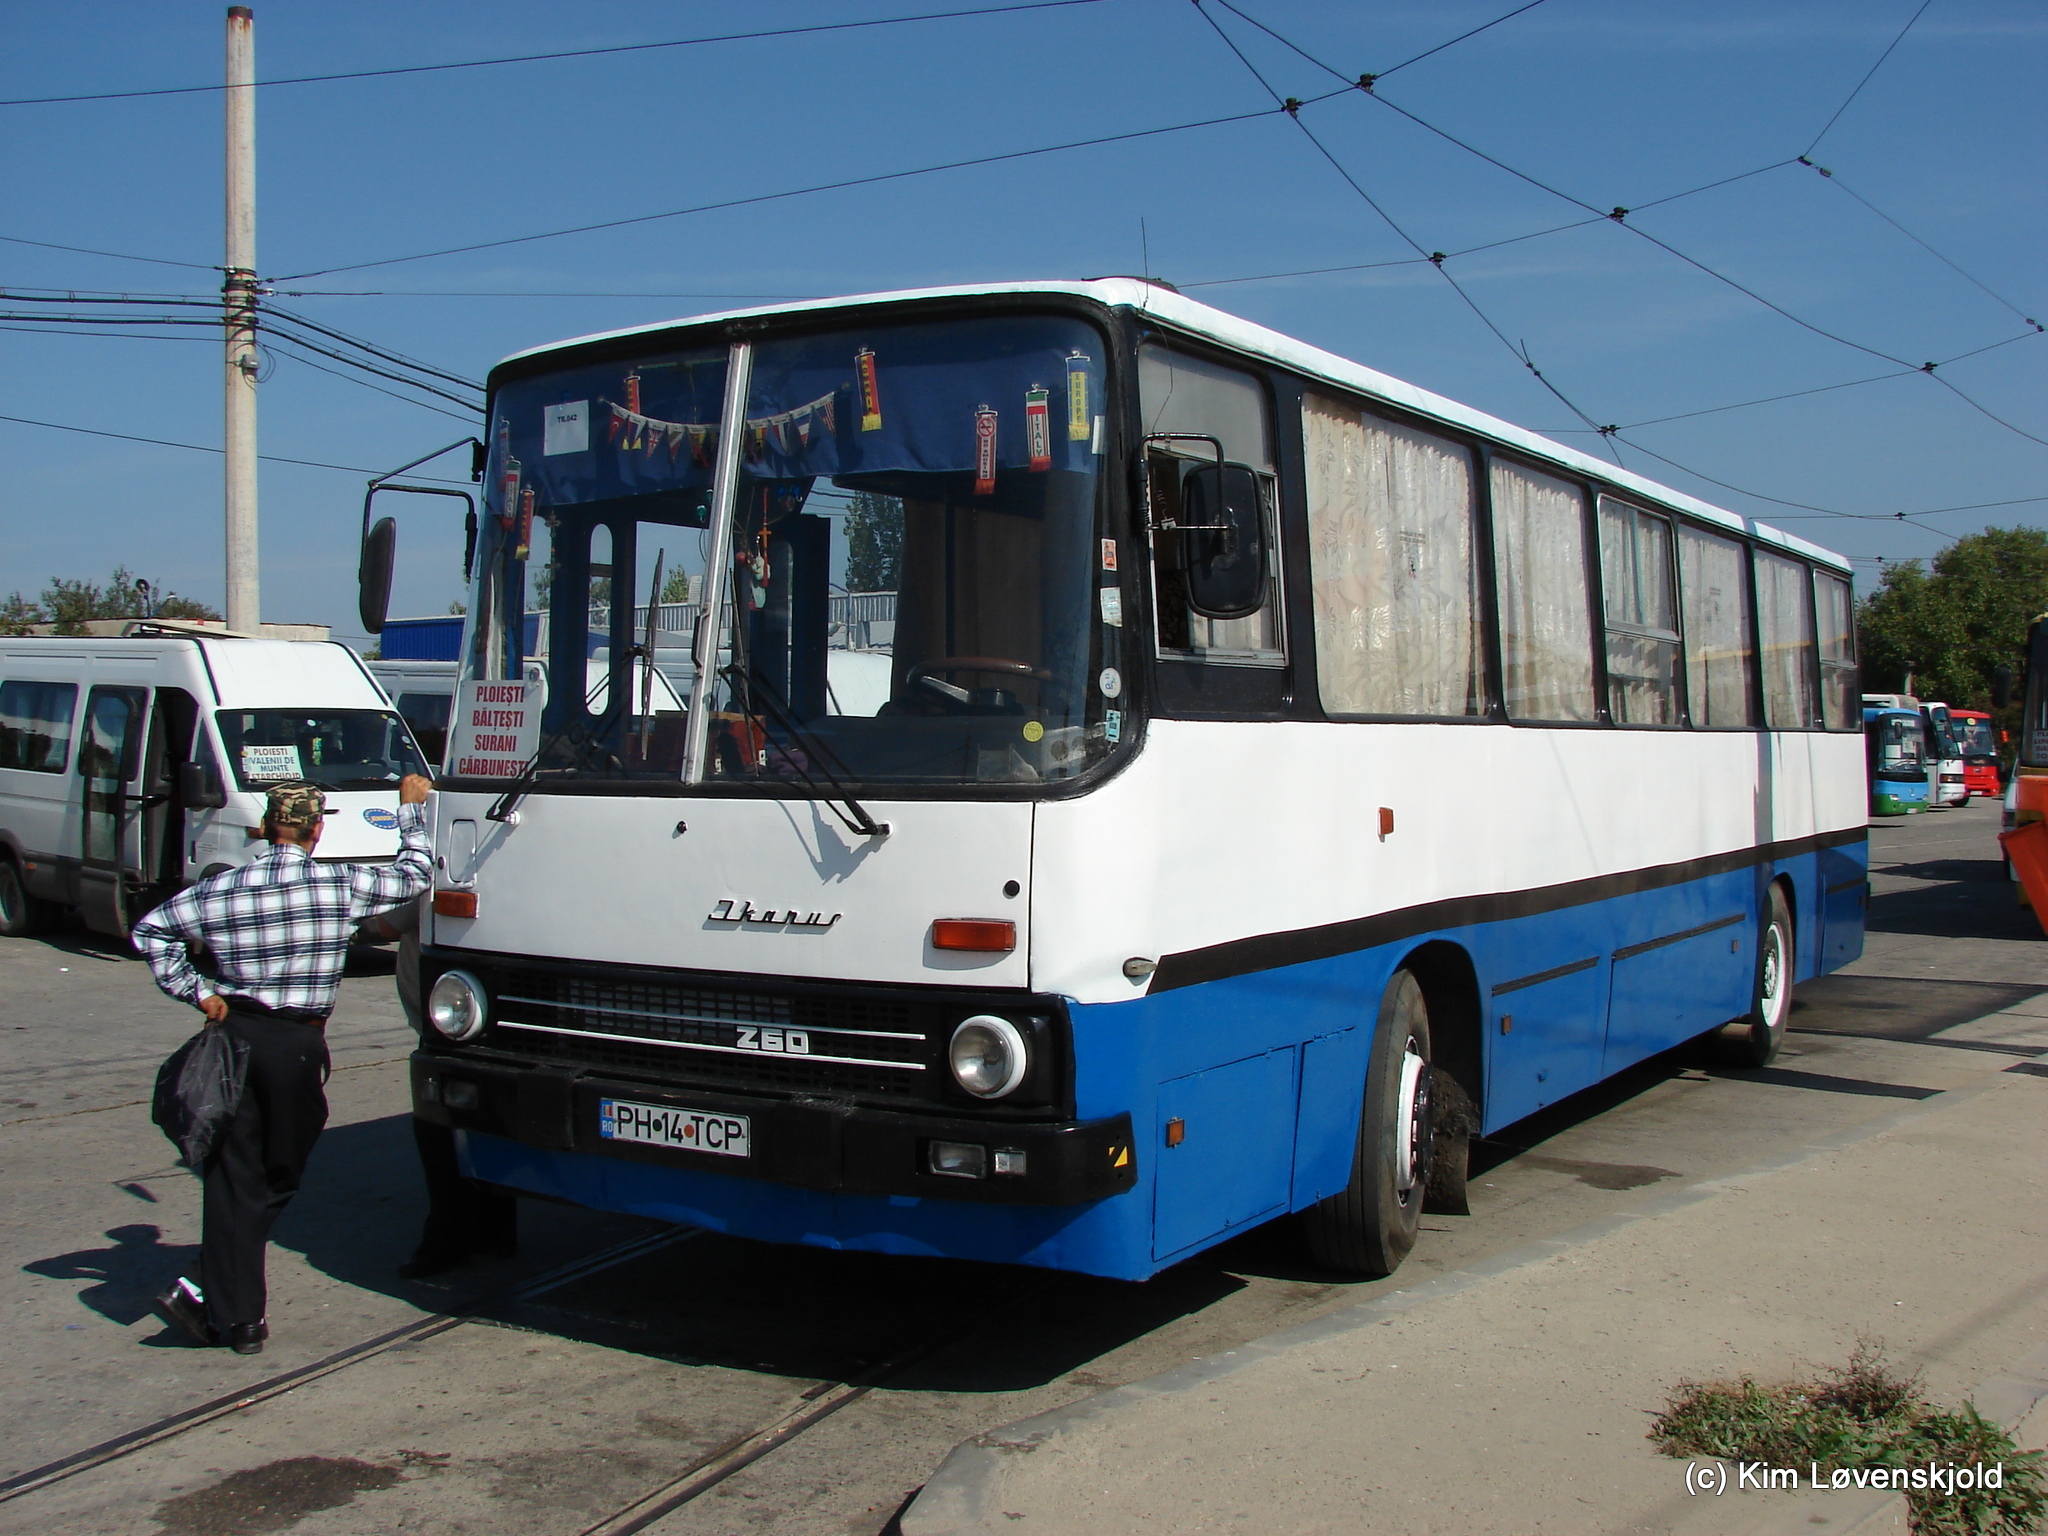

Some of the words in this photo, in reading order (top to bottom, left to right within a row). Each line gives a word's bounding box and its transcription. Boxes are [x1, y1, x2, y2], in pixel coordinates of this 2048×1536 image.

[1034, 415, 1043, 456] ITALY
[253, 748, 288, 756] PLOIESTI
[474, 734, 517, 752] SURANI
[707, 899, 844, 927] Ikarus
[736, 1025, 809, 1055] 260
[602, 1120, 613, 1133] RO
[617, 1106, 651, 1139] PH
[661, 1112, 684, 1143] 14
[690, 1115, 742, 1150] TCP
